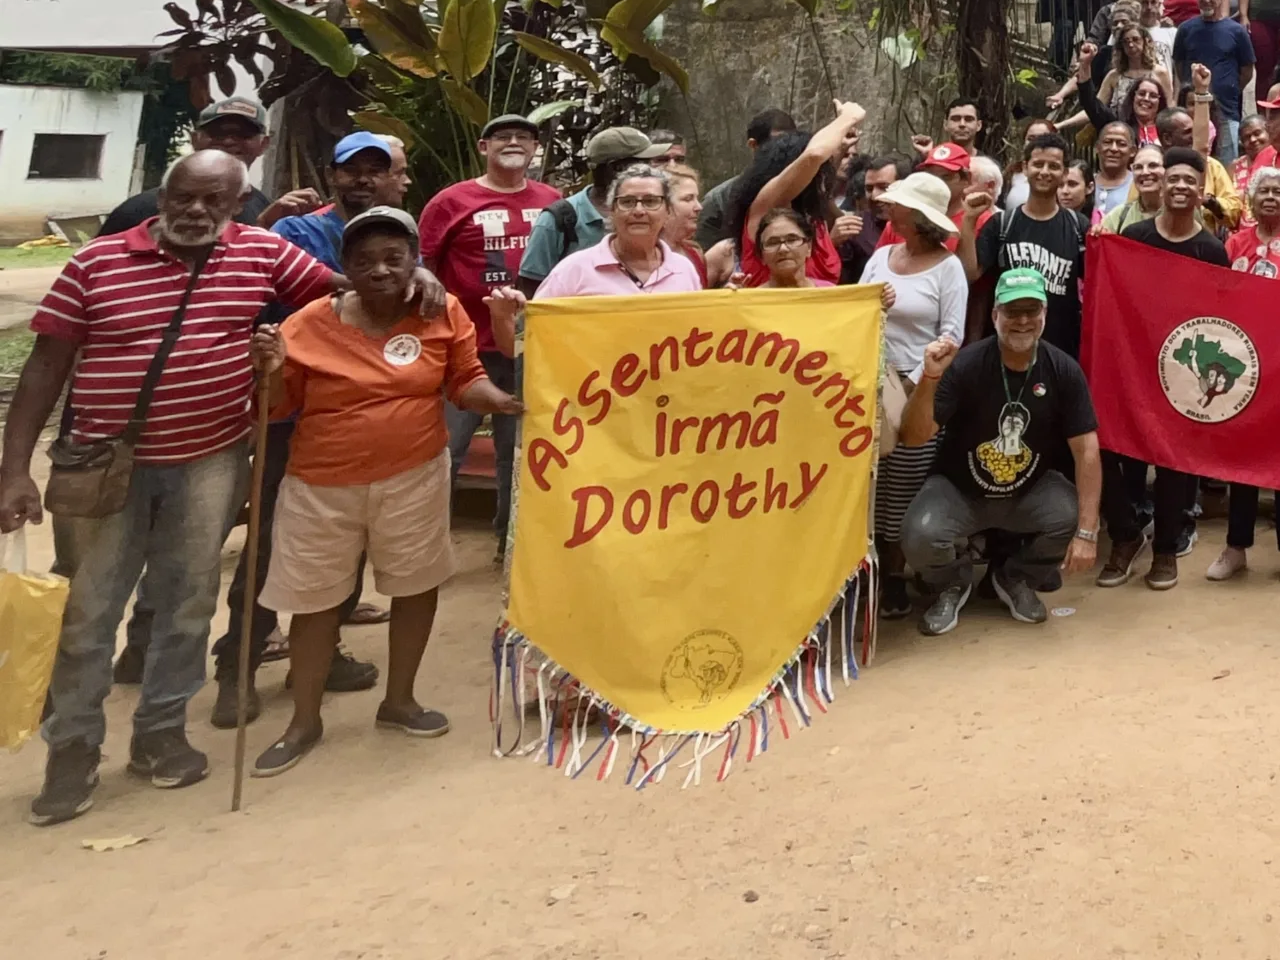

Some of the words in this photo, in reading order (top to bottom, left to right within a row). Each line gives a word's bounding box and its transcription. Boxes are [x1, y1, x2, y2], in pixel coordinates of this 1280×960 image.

[478, 212, 503, 220] NEW
[1010, 242, 1073, 279] LEVANTE
[485, 271, 511, 282] EST.
[1168, 331, 1181, 344] DOS
[1181, 318, 1245, 339] TRABALHADORES
[1243, 339, 1258, 369] RURAIS
[1159, 345, 1170, 392] MOVIMENTO
[1233, 389, 1253, 411] TERRA
[655, 390, 786, 458] irmã
[1185, 409, 1212, 421] BRASIL
[563, 462, 829, 549] Dorothy
